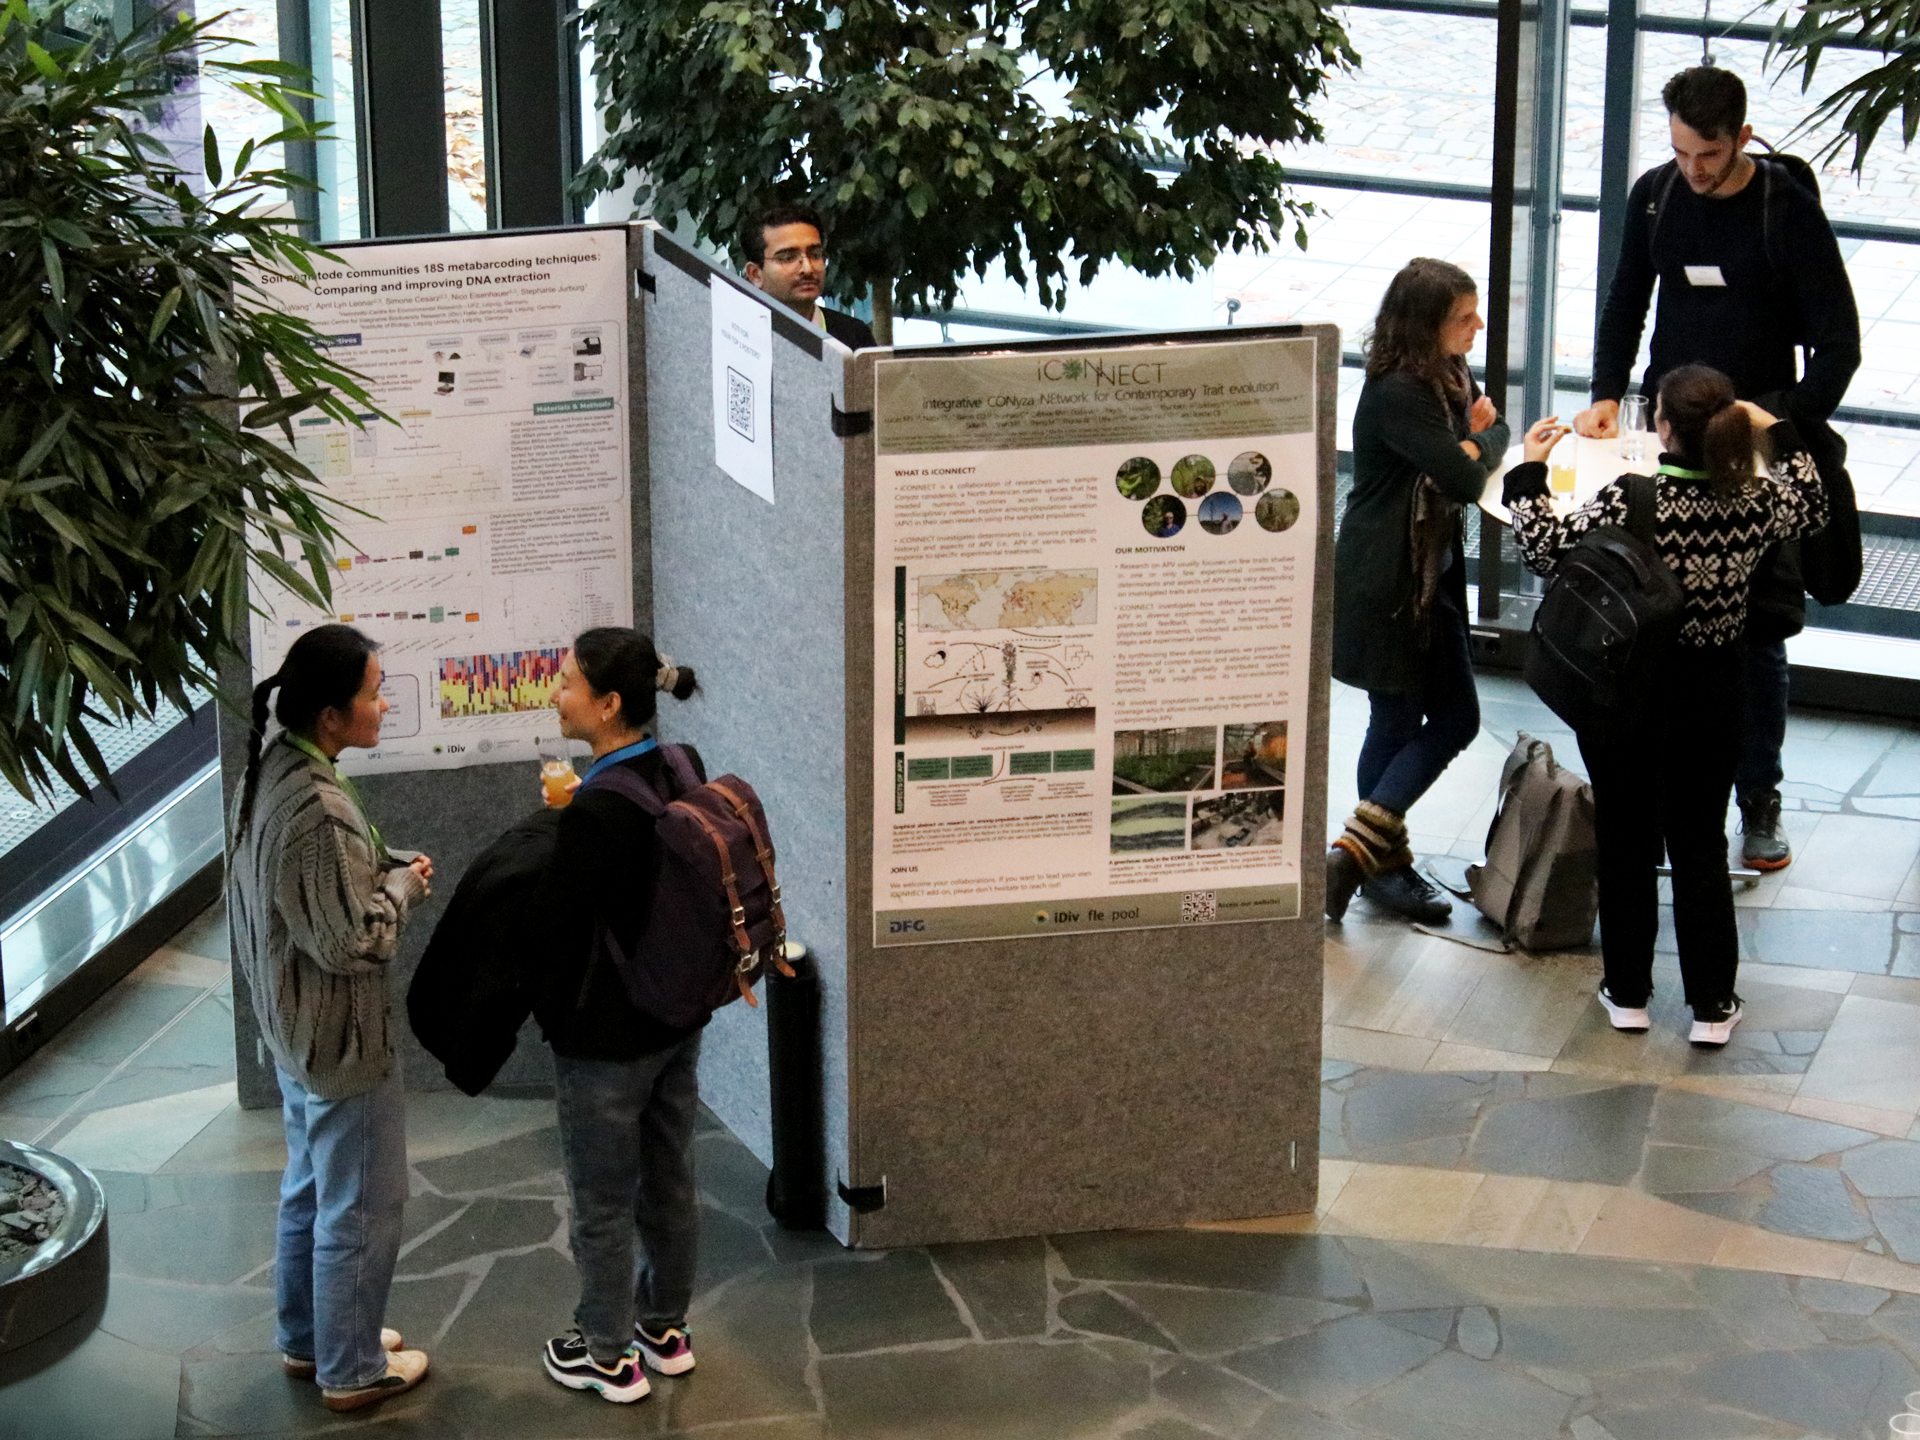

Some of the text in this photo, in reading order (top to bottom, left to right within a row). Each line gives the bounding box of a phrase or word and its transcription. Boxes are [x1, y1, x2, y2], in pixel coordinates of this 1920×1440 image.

[346, 265, 420, 279] communities
[424, 263, 445, 274] 18S
[448, 258, 533, 272] metabarcoding
[535, 253, 601, 266] techniques:
[314, 272, 551, 297] Comparing and improving DNA extraction
[922, 380, 1279, 413] integrative CONyza NEtwork for Contemporary Trait evolution
[894, 469, 919, 477] WHAT
[931, 466, 976, 475] iCONNECT?
[1114, 544, 1185, 554] OUR MOTIVATION
[447, 744, 466, 754] iDiv
[890, 866, 907, 874] JOIN
[1054, 911, 1080, 924] iDiv
[889, 919, 926, 933] DFG
